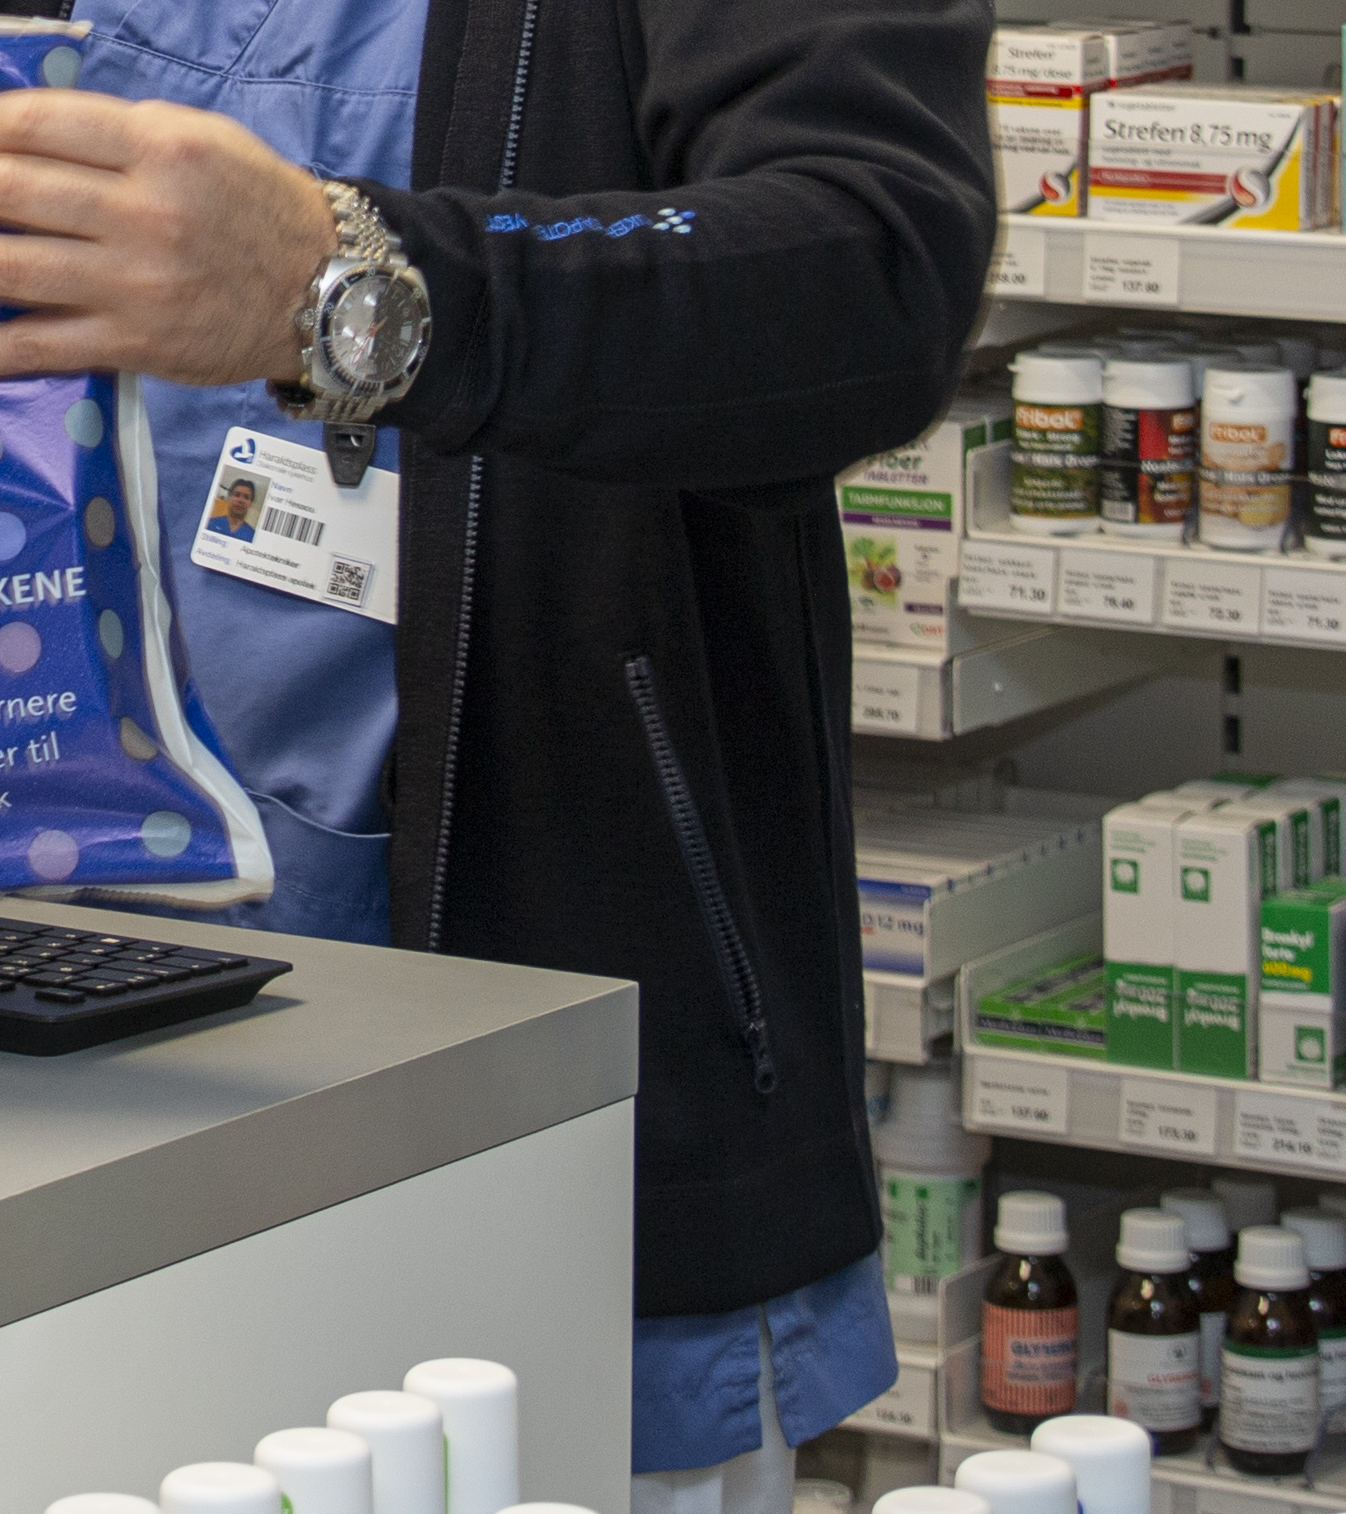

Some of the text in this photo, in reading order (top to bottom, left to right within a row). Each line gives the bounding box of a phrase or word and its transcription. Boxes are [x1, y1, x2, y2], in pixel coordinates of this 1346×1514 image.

[1103, 119, 1186, 142] Strefen
[1235, 130, 1272, 154] mg
[259, 449, 317, 475] Haraldsplass
[27, 733, 63, 768] til
